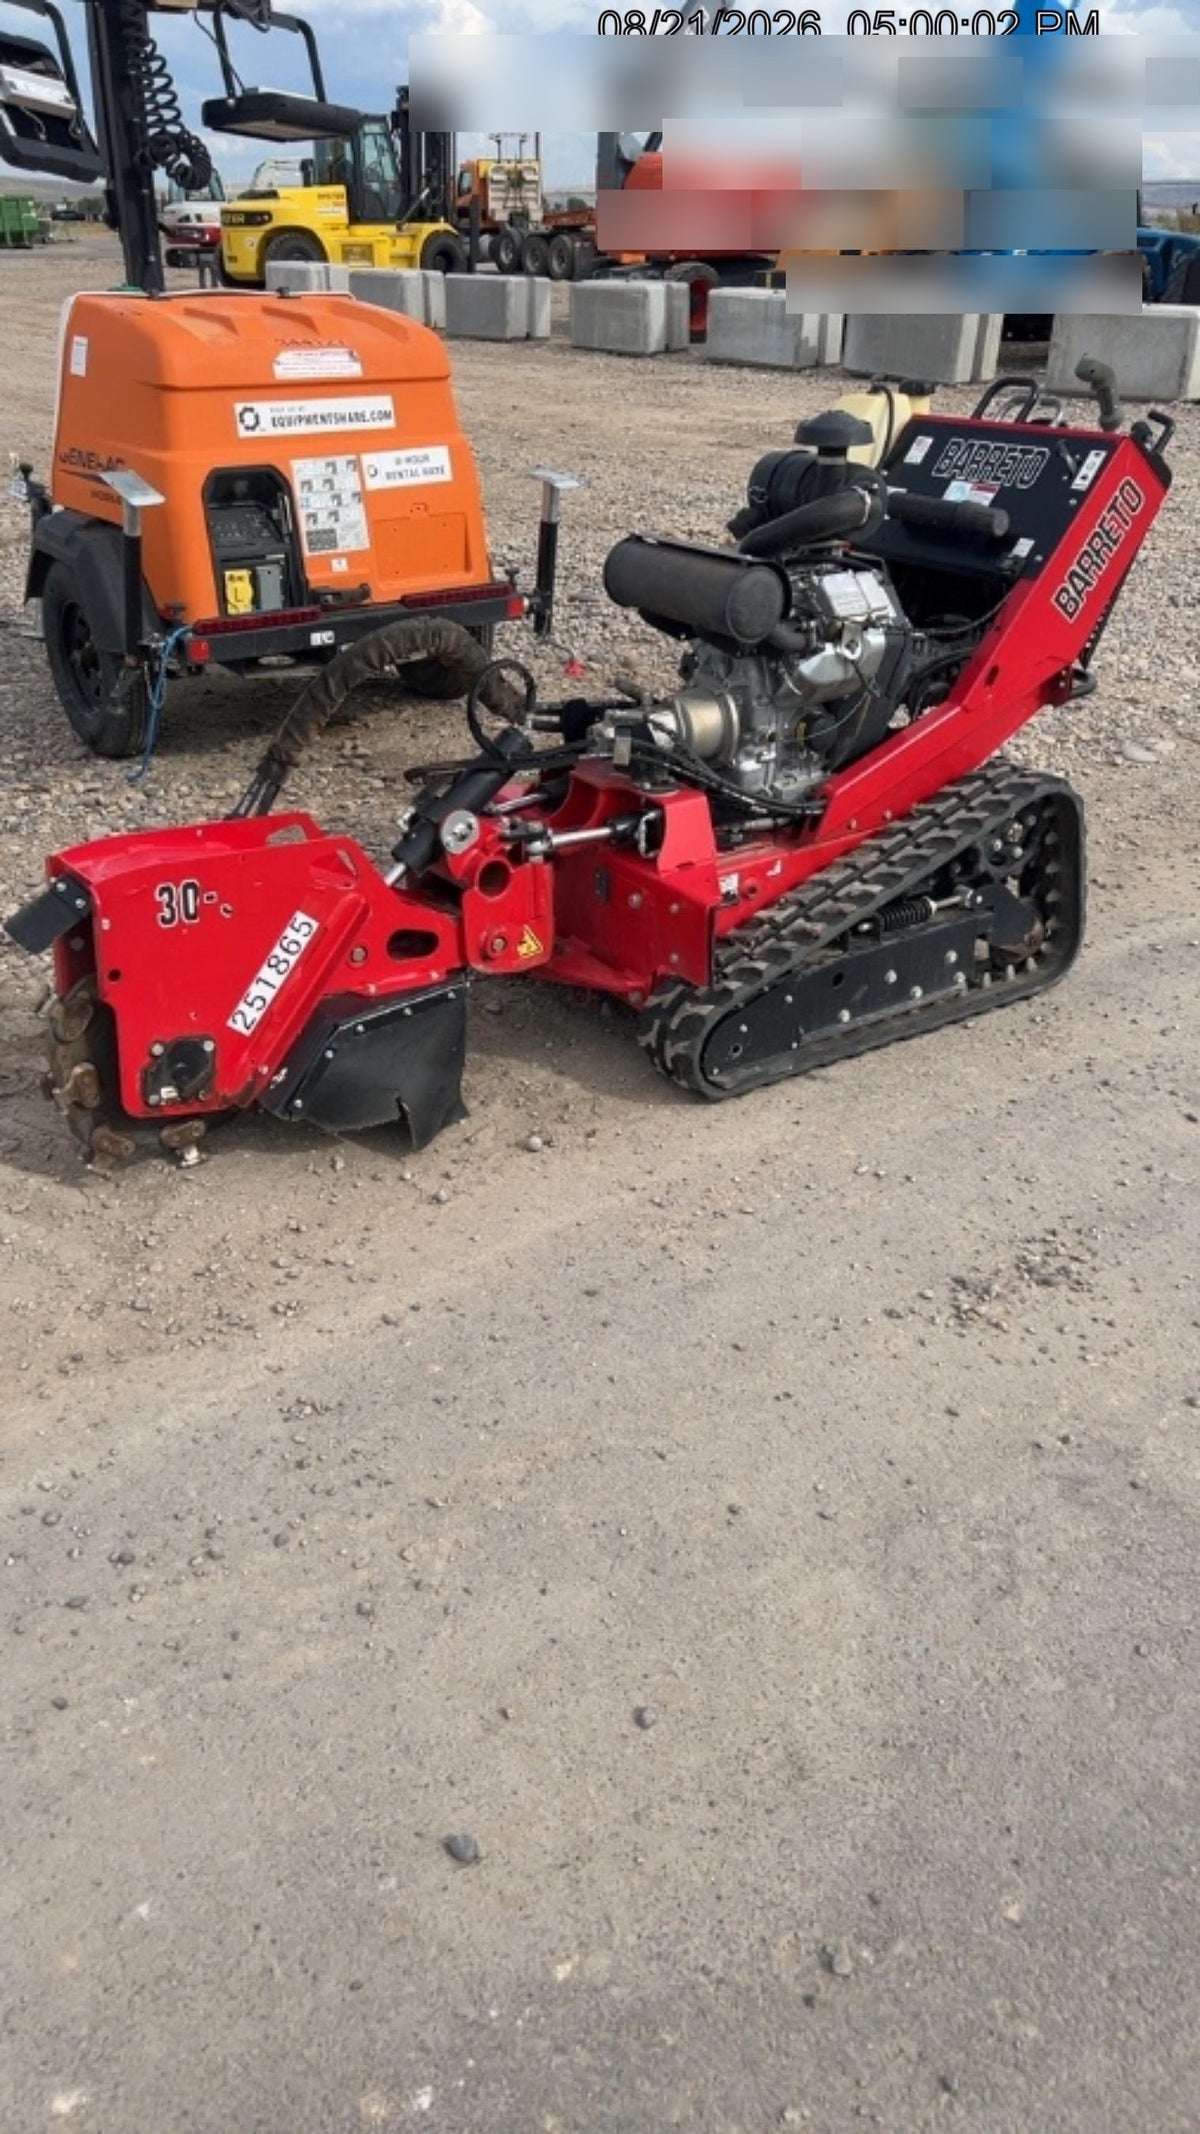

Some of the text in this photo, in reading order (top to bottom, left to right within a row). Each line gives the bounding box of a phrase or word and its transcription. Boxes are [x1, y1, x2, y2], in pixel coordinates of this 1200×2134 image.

[271, 409, 392, 429] EQUIPMENTSHARE.COM
[931, 438, 1050, 489] BARRETO
[1051, 476, 1146, 624] BARRETO
[231, 916, 315, 1031] 251865
